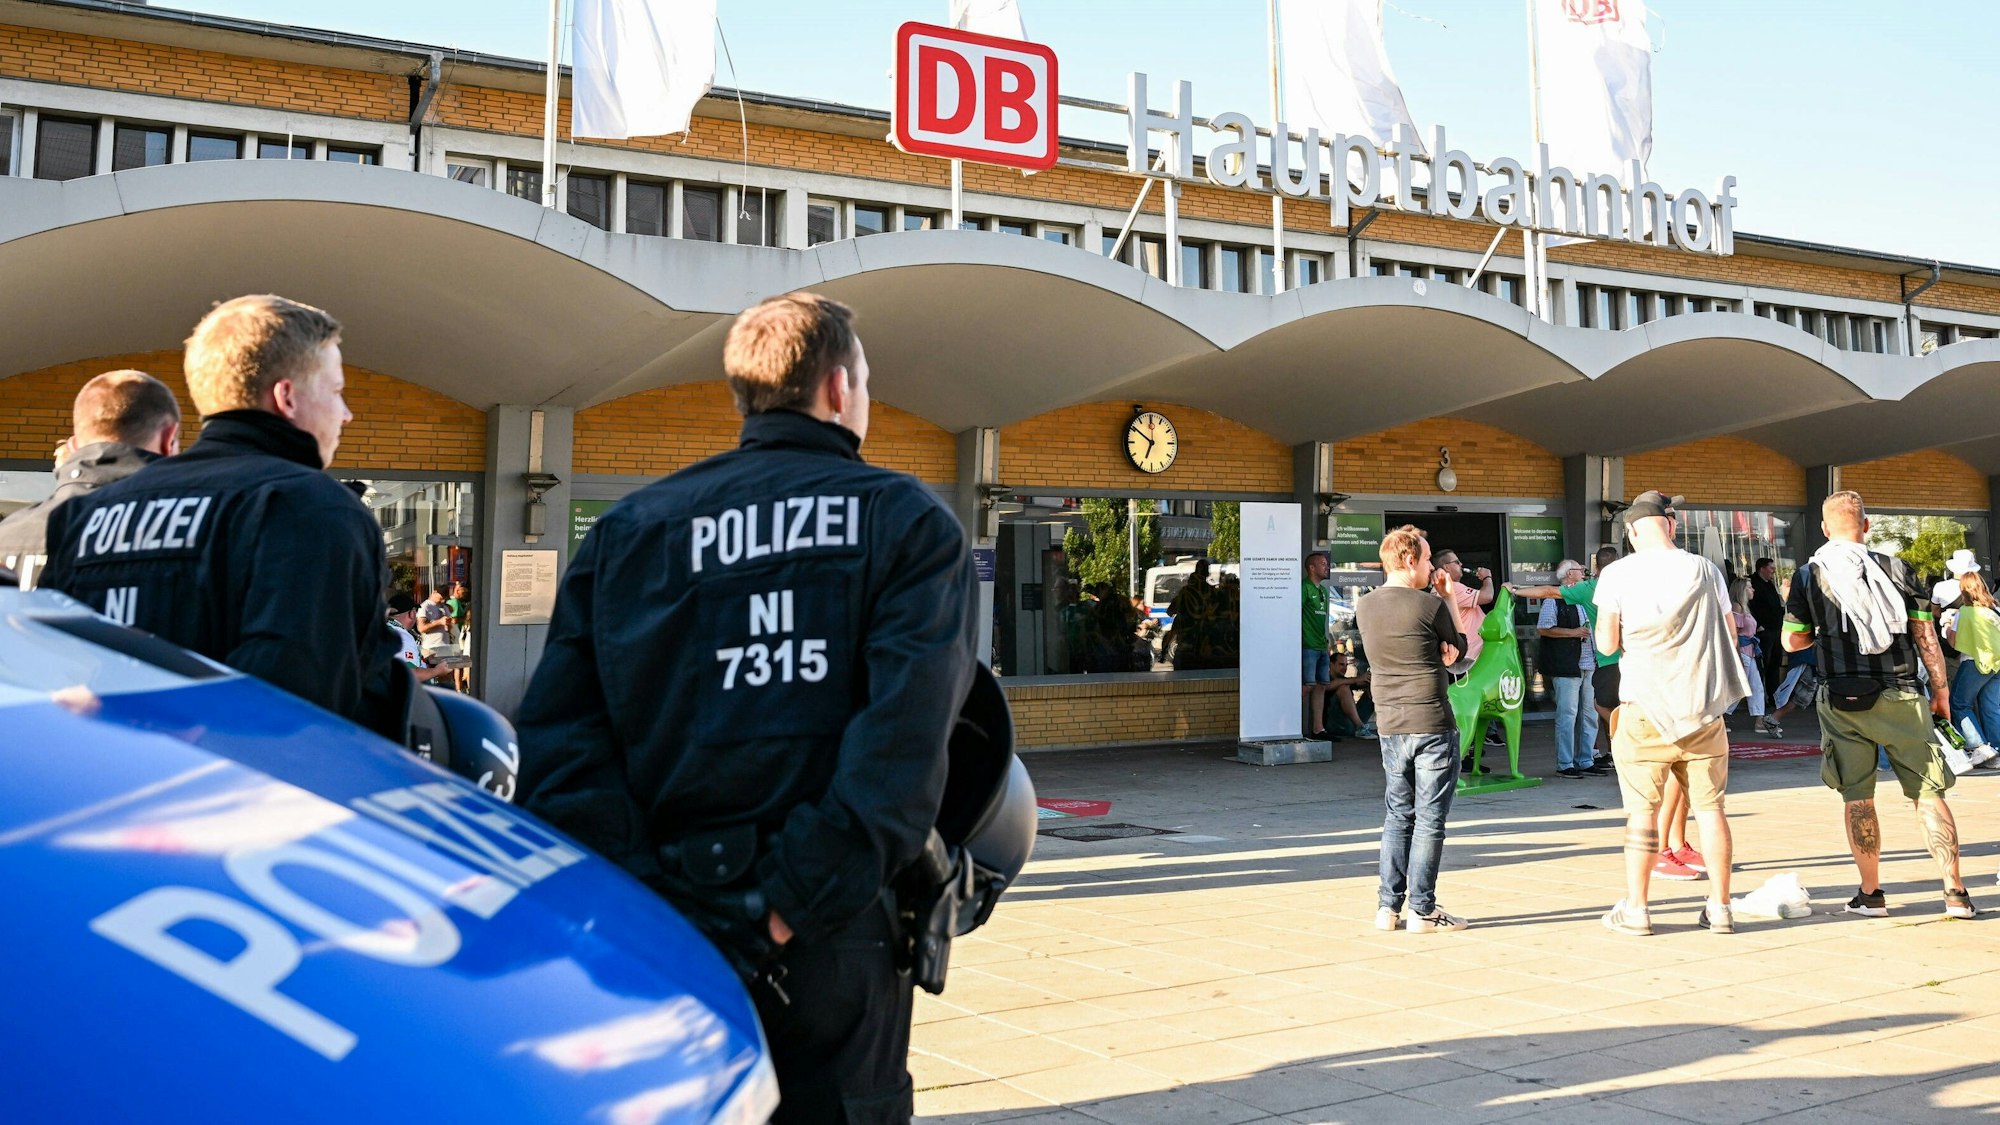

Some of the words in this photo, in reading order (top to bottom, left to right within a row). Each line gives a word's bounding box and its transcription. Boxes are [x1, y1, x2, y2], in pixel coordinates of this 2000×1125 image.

[918, 45, 1039, 145] DB
[1127, 71, 1737, 257] Hauptbahnhof
[1441, 447, 1450, 468] 3
[78, 496, 212, 558] POLIZEI
[691, 495, 859, 573] POLIZEI
[105, 587, 139, 626] NI
[749, 589, 794, 637] NI
[716, 639, 828, 691] 7315
[89, 781, 589, 1063] POLIZEI
